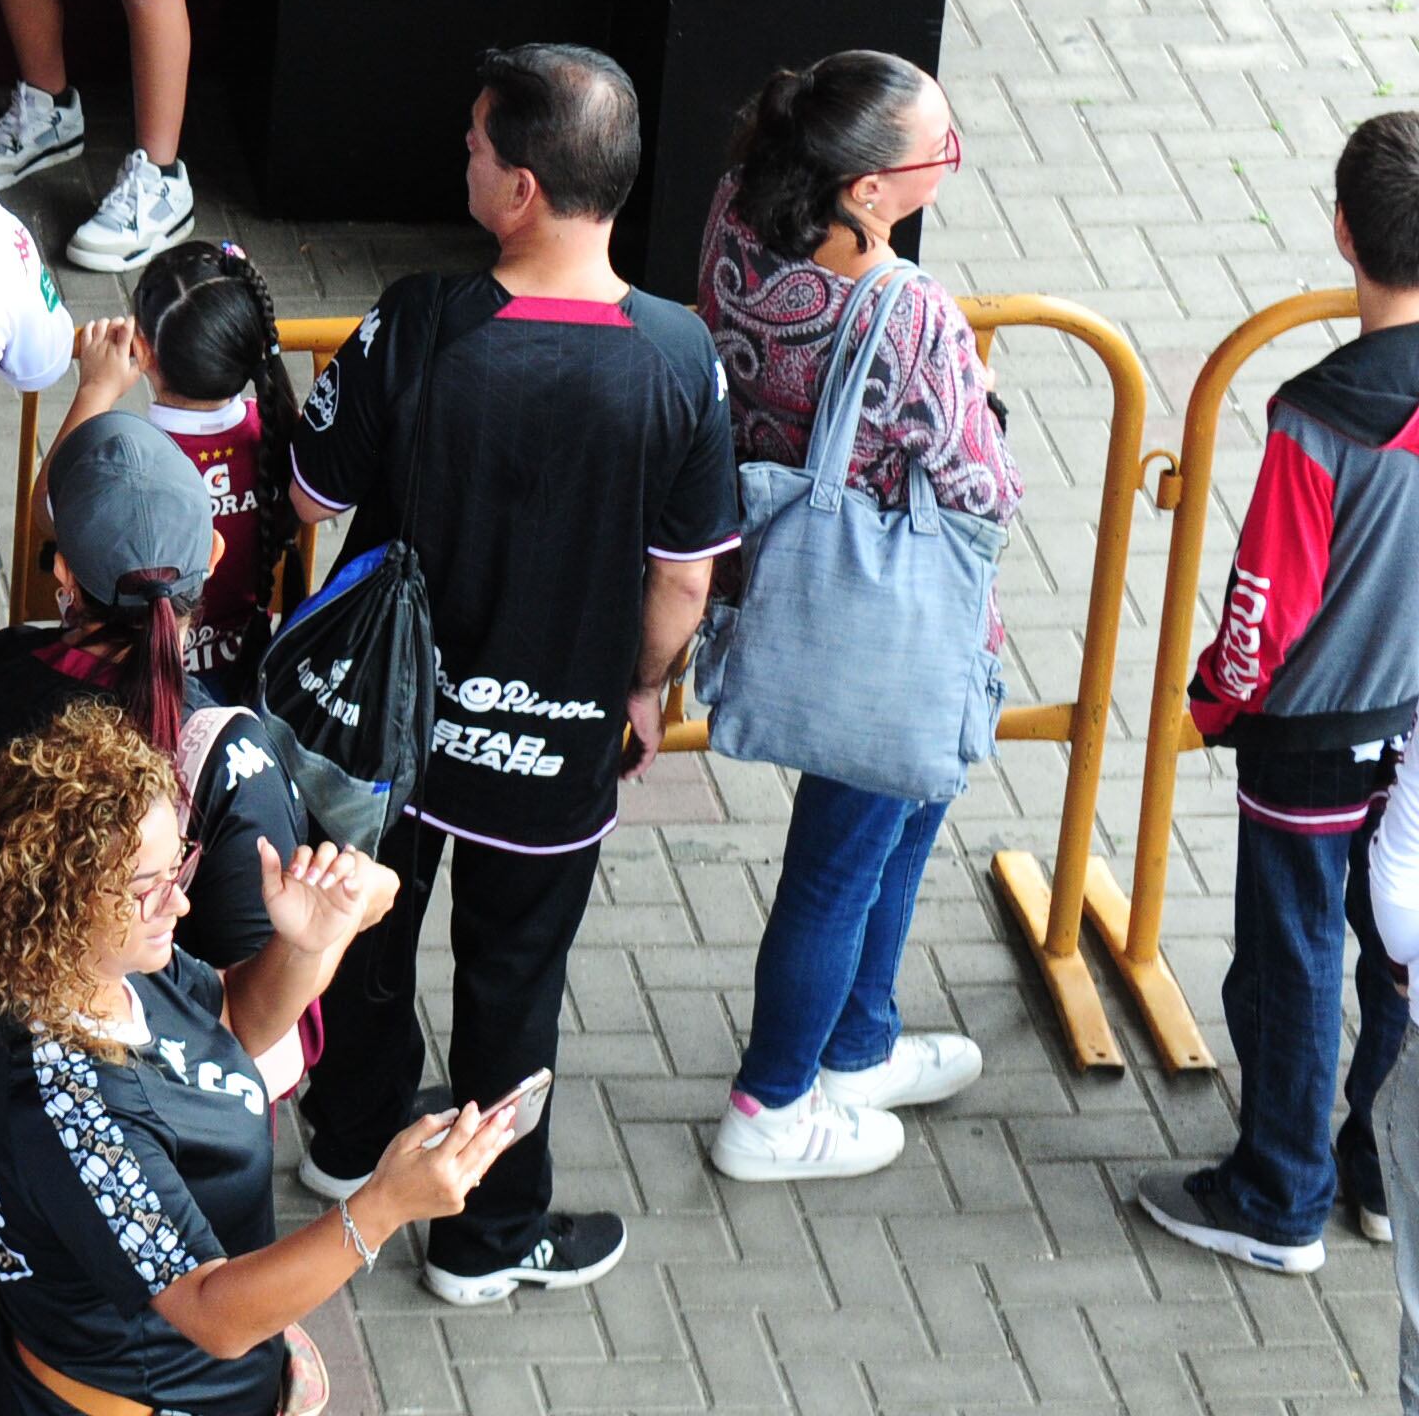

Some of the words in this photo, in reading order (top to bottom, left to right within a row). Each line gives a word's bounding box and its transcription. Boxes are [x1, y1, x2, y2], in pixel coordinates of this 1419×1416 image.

[496, 679, 606, 721] Pinos
[435, 718, 546, 757] STAR
[444, 741, 564, 778] CARS
